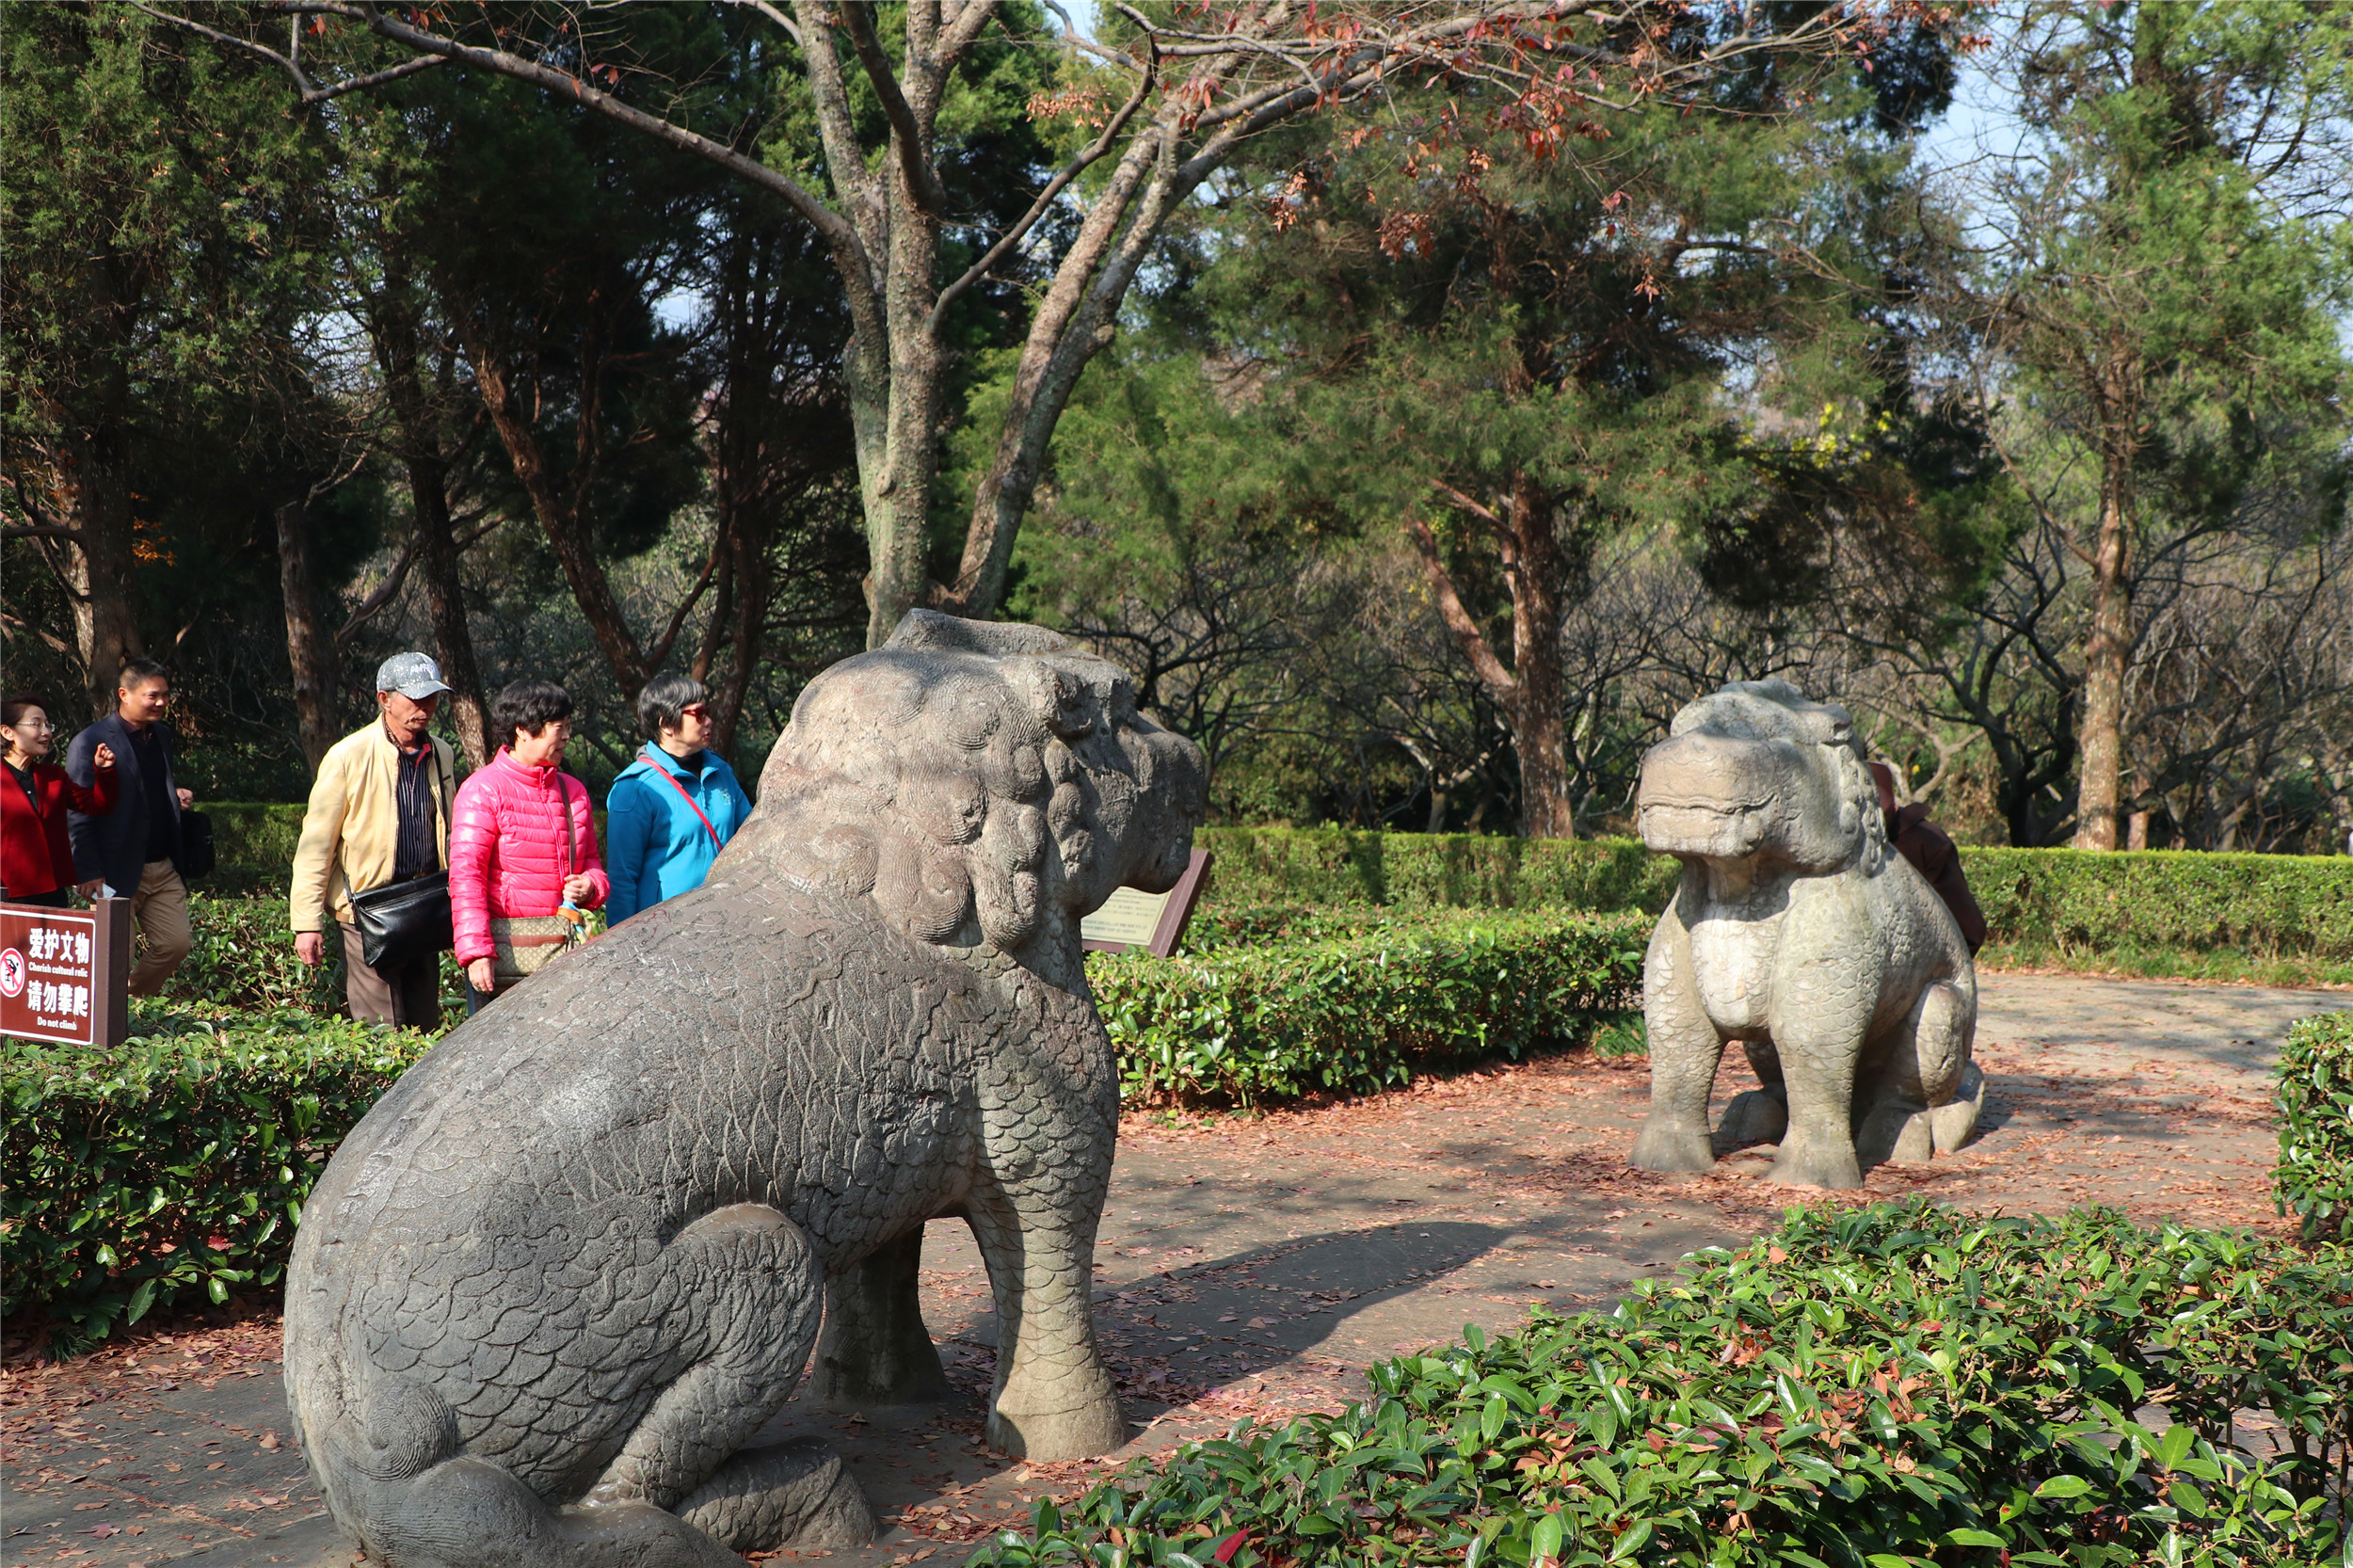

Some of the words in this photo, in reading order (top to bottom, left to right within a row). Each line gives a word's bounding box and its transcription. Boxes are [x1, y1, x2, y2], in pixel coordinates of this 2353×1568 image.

[29, 928, 89, 964] 爱护文物
[28, 962, 52, 973] Cherish
[52, 966, 74, 976] cultural
[74, 968, 88, 978] relic
[27, 980, 88, 1017] 请勿攀爬
[38, 1016, 47, 1026] Do
[47, 1019, 59, 1028] not
[59, 1020, 77, 1031] climb
